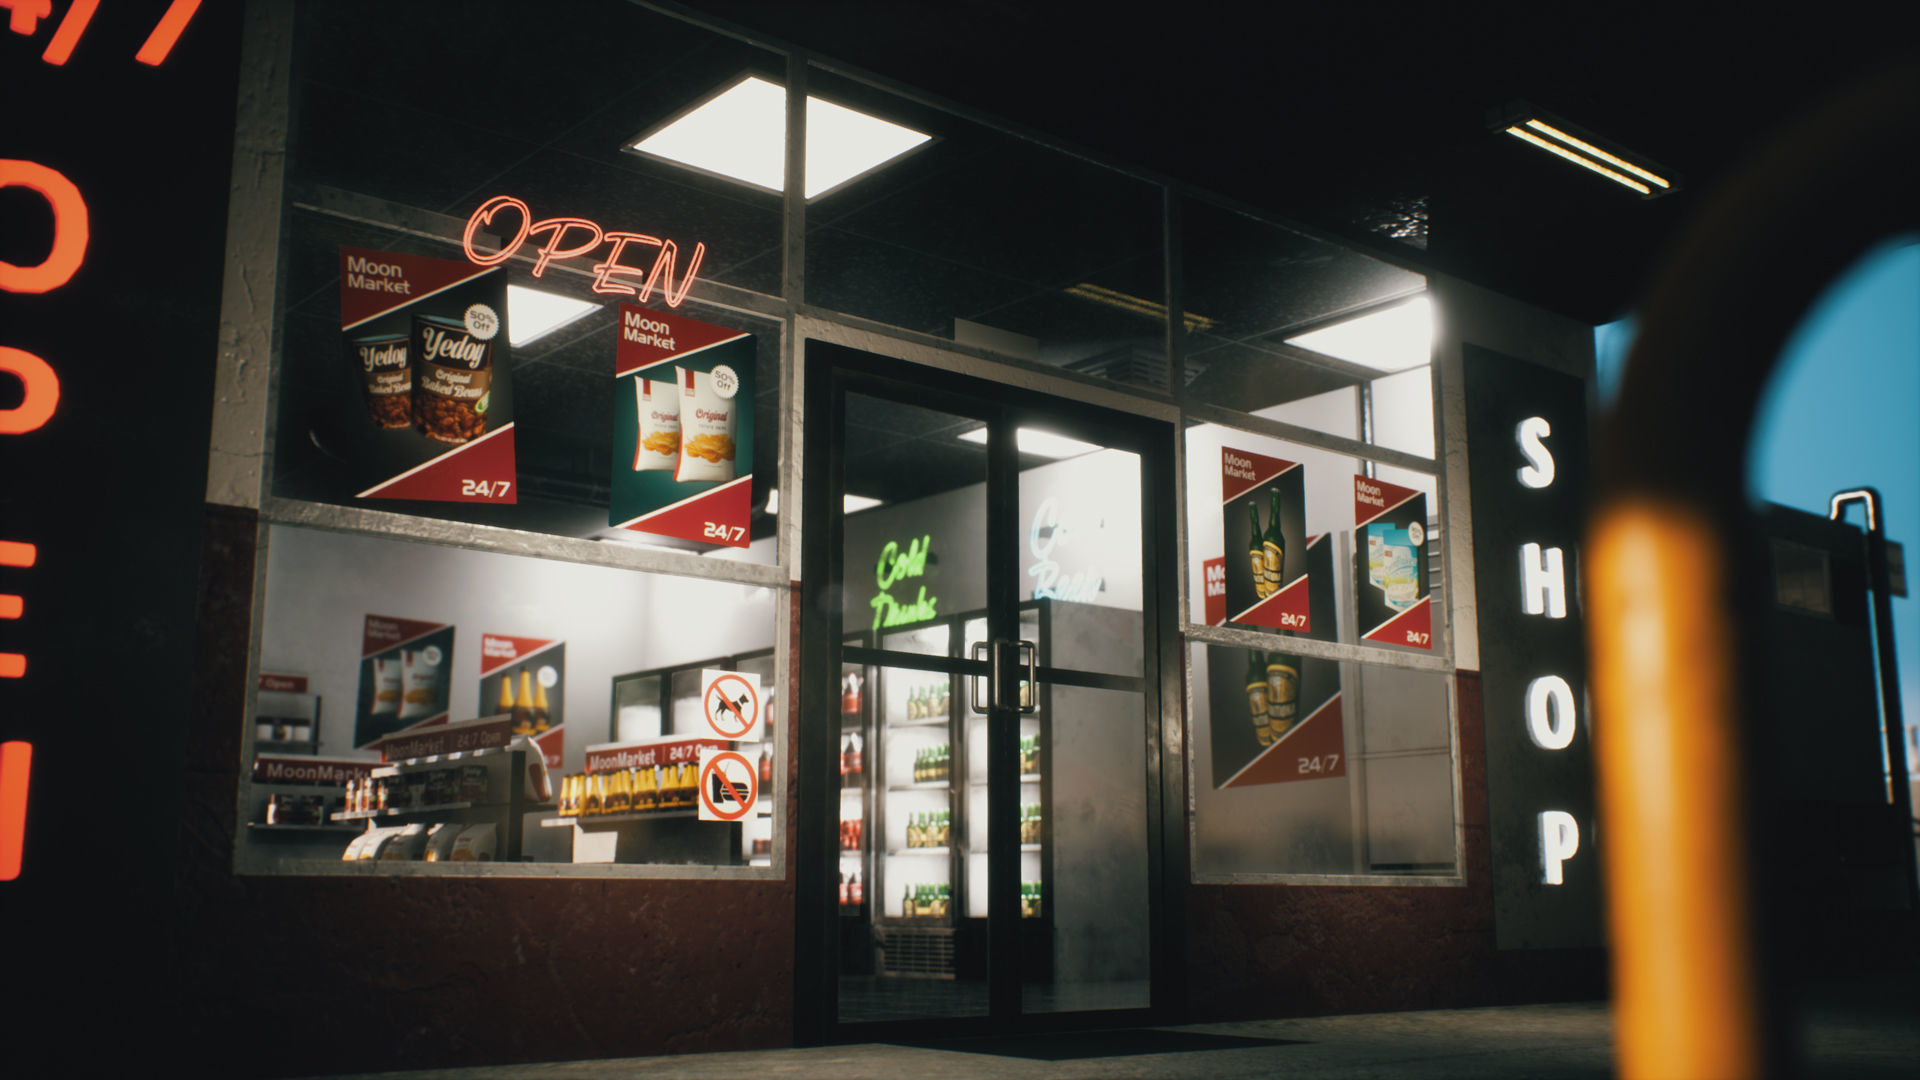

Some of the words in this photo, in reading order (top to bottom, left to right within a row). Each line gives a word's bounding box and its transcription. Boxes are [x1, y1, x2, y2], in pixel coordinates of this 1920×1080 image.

[463, 195, 705, 309] OPEN
[347, 255, 403, 278] Moon
[348, 273, 411, 294] Market
[625, 310, 670, 335] Moon
[422, 326, 486, 370] Yedoy
[624, 326, 676, 351] Market
[1224, 452, 1252, 469] Moon
[1224, 466, 1256, 481] Market
[462, 479, 511, 498] 24/7
[1357, 480, 1381, 496] Moon
[1357, 492, 1384, 508] Market
[704, 521, 746, 542] 24/7
[876, 534, 931, 590] Cold
[1280, 612, 1306, 627] 24/7
[1406, 630, 1429, 645] 24/7
[1516, 416, 1580, 885] SHOP
[590, 748, 656, 769] MoonMarket
[670, 745, 694, 760] 24/7
[1298, 754, 1339, 774] 24/7
